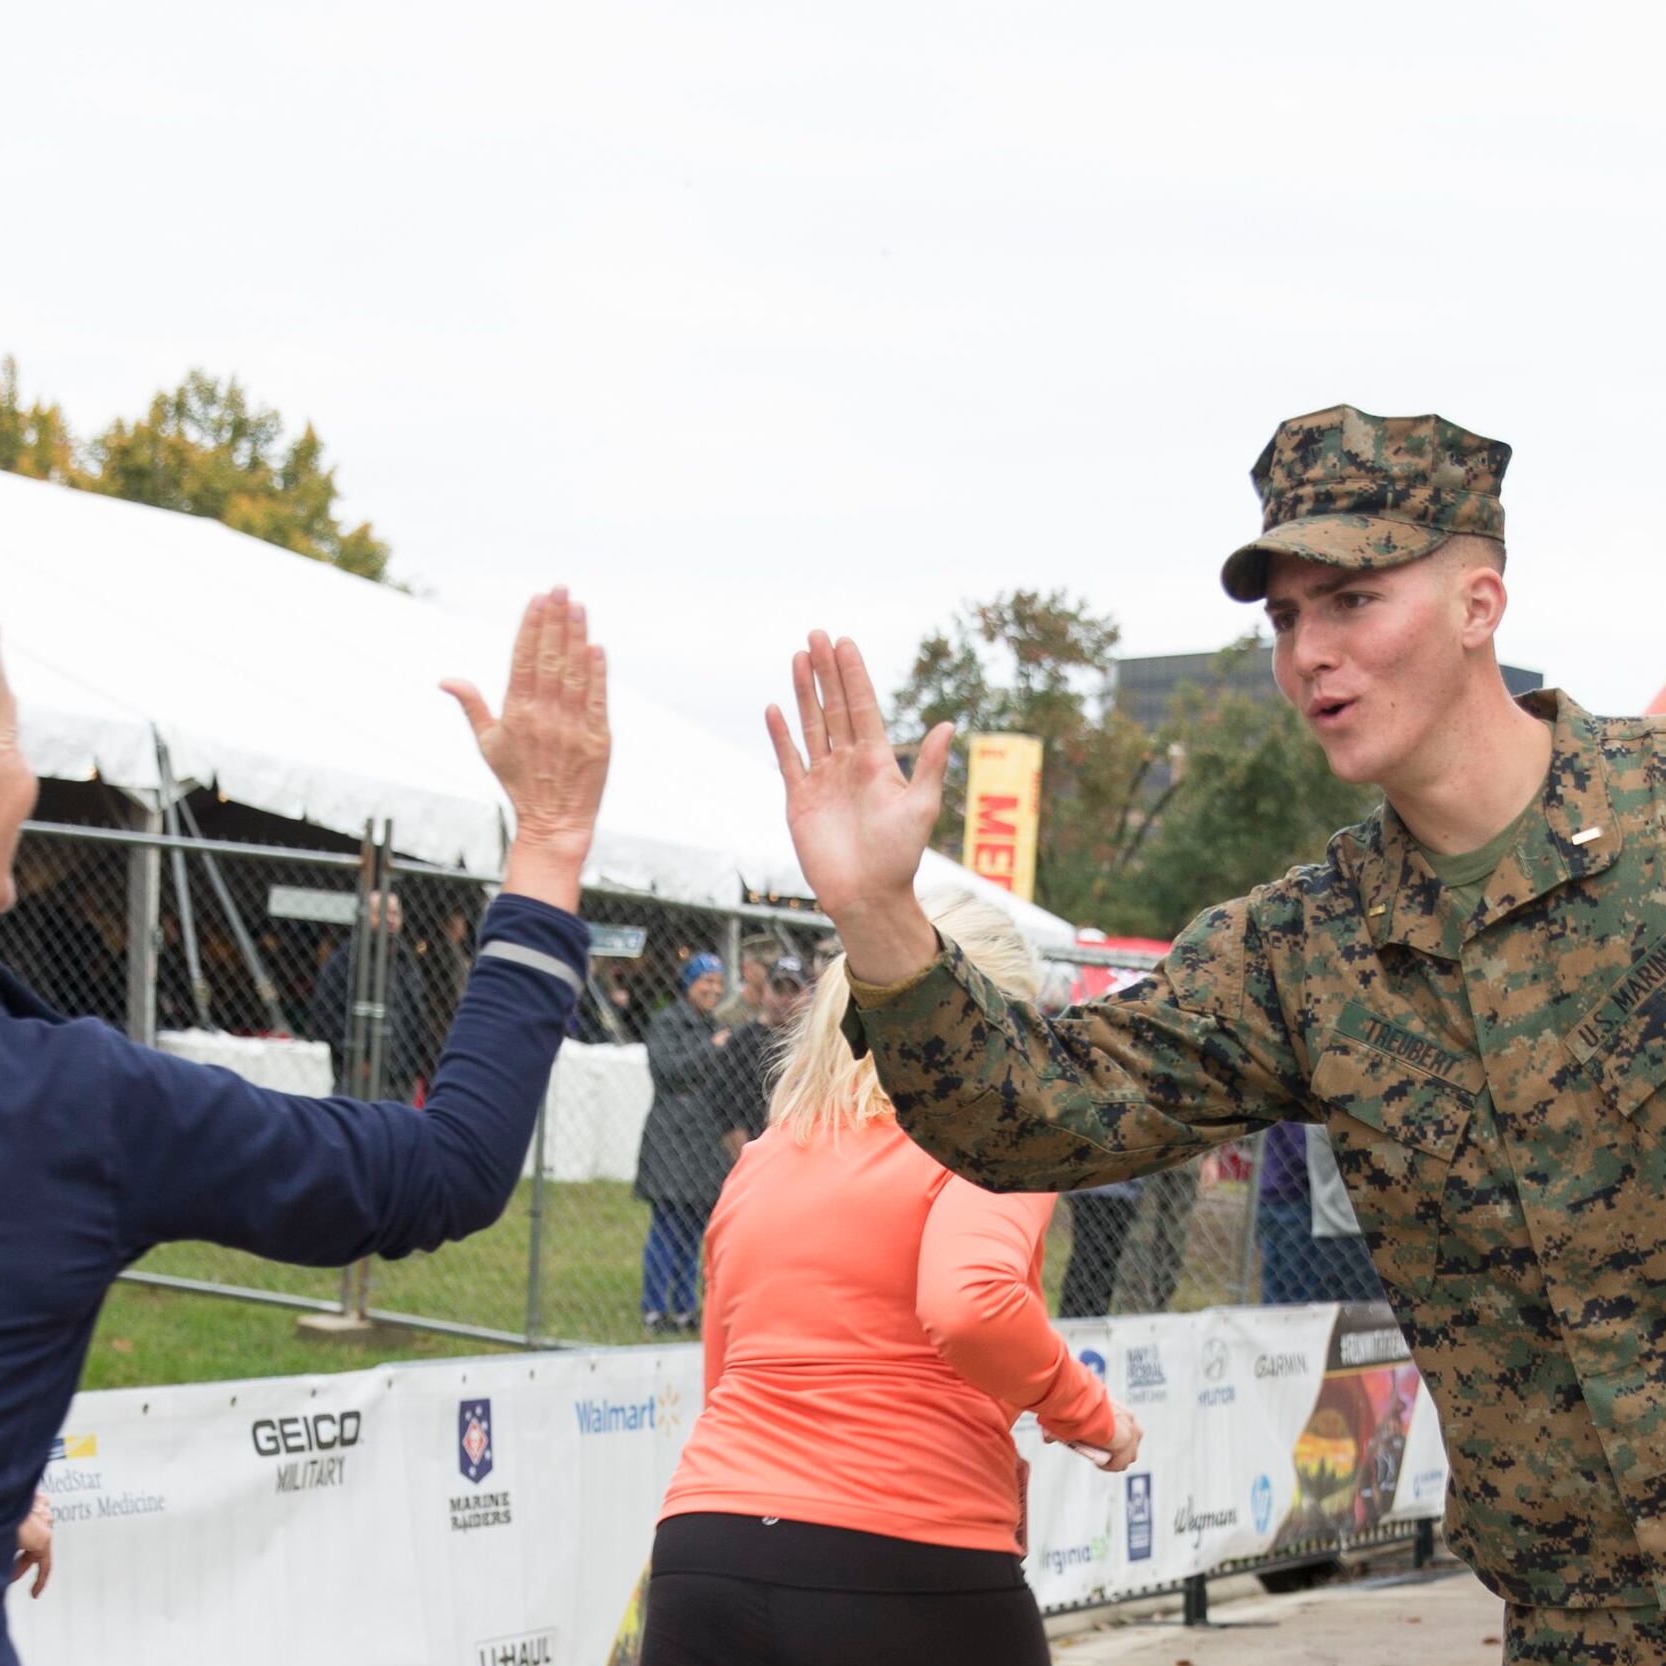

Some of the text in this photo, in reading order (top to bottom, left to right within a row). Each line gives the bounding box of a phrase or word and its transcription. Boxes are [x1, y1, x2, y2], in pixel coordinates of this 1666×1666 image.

[1365, 1016, 1461, 1077] TREUBERT
[1578, 1010, 1619, 1048] U.S.
[1254, 1353, 1307, 1379] GARMIN
[252, 1410, 361, 1456] GEICO
[575, 1397, 655, 1433] Walmart
[276, 1456, 345, 1493] MILITARY
[49, 1490, 166, 1529] ports Medicine
[449, 1492, 510, 1512] MARINE
[451, 1511, 512, 1533] RAIDERS
